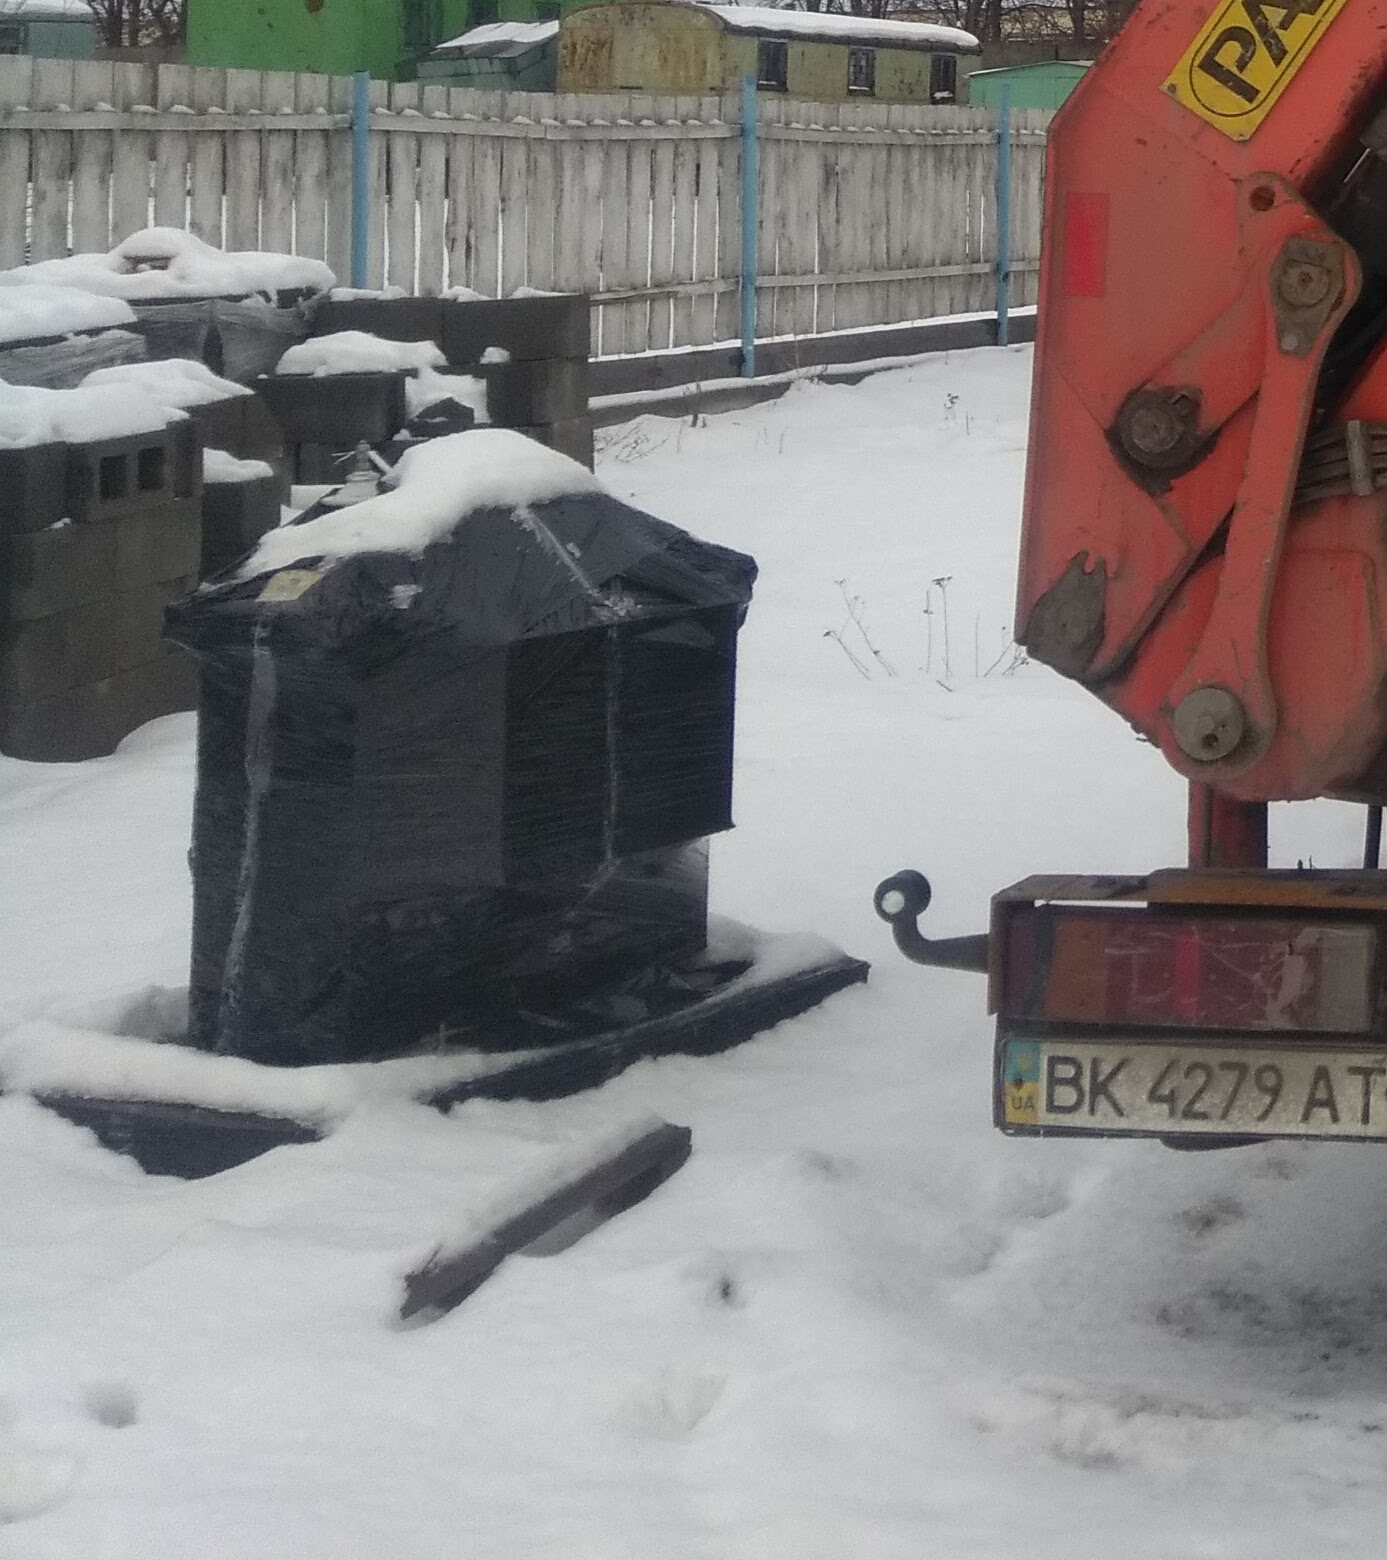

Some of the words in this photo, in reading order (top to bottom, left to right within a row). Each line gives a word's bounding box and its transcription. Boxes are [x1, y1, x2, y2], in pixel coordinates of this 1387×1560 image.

[1011, 1095, 1035, 1112] UA
[1045, 1055, 1133, 1118] BK
[1146, 1058, 1284, 1122] 4279
[1300, 1063, 1387, 1125] AT
